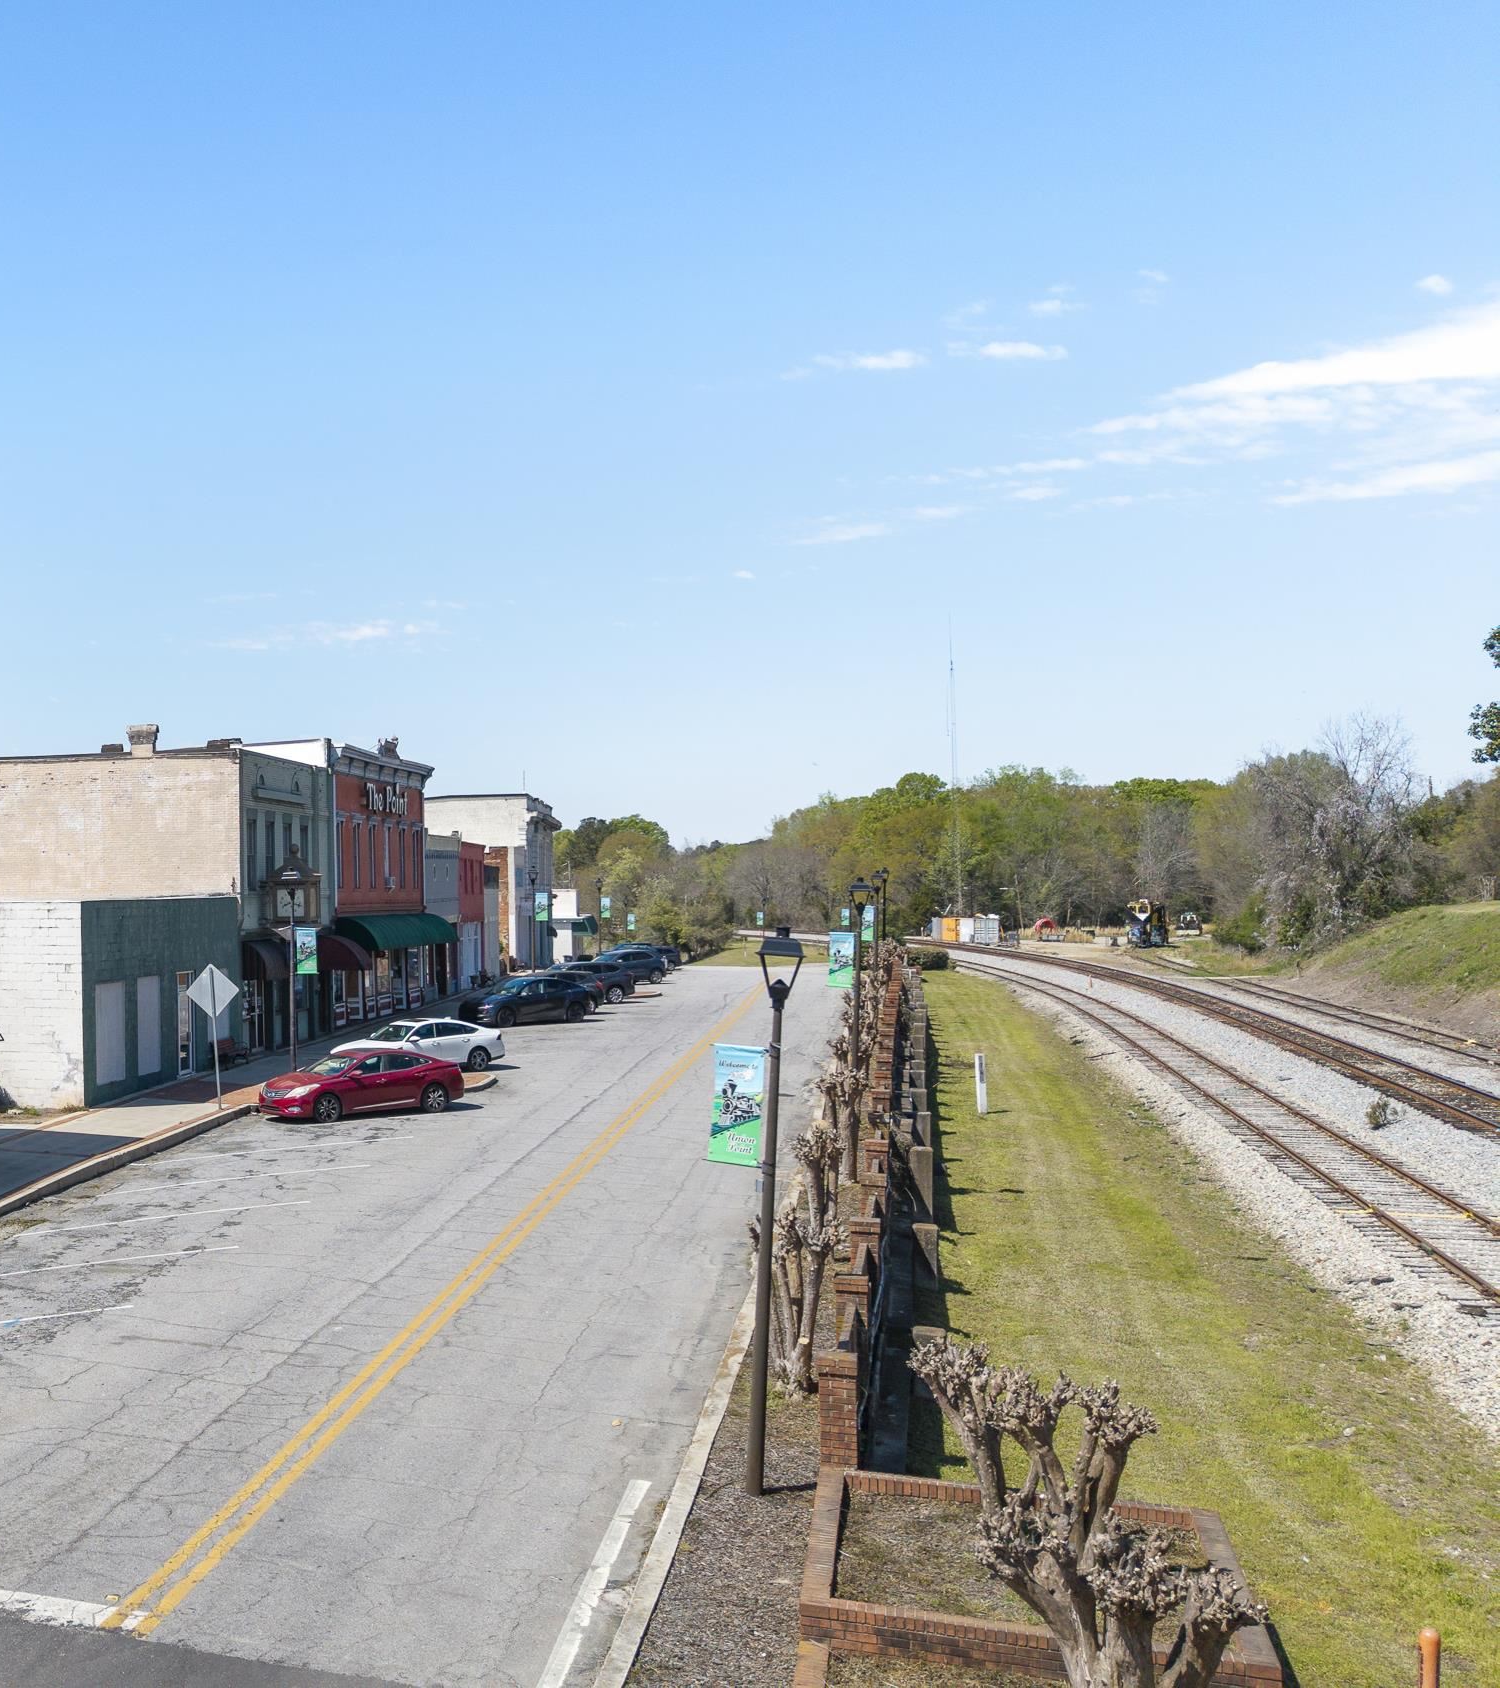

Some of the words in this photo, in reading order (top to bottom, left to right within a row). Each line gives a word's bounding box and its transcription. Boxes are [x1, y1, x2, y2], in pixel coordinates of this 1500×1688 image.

[366, 782, 383, 811] The
[386, 782, 408, 816] Point
[718, 1060, 750, 1069] Welcome
[727, 1132, 756, 1144] Union
